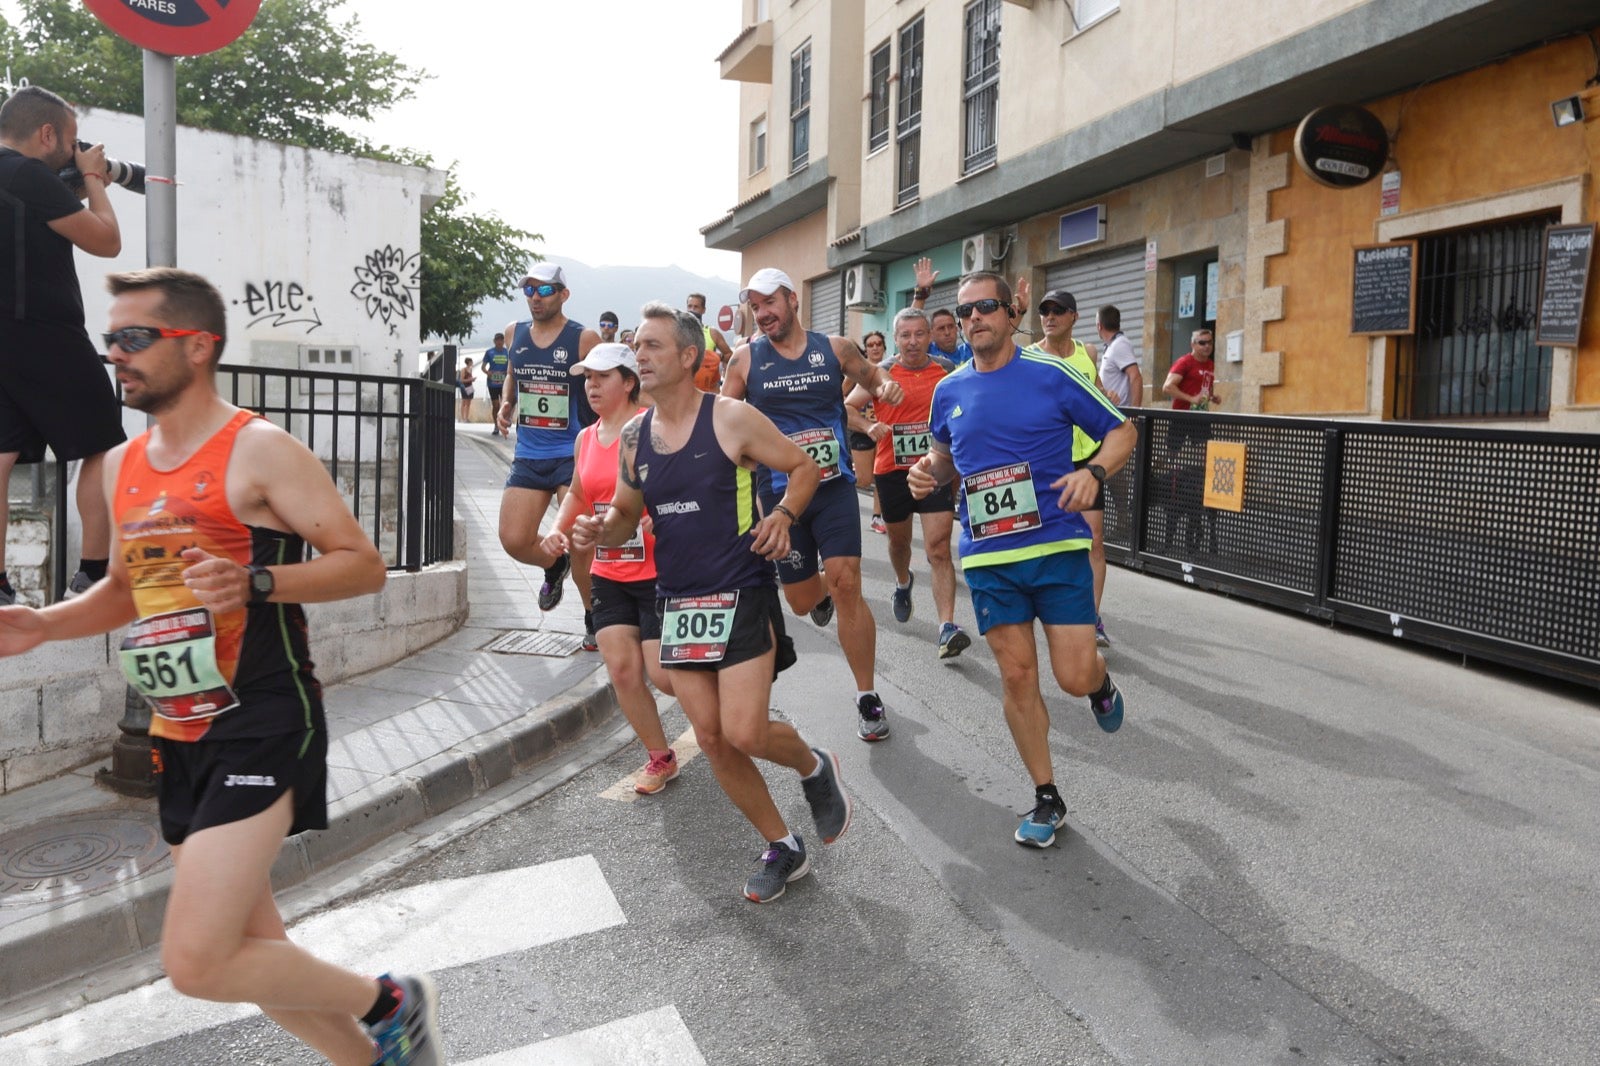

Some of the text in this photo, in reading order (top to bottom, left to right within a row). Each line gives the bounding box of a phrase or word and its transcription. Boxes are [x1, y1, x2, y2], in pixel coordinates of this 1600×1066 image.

[542, 369, 567, 377] PAZITO
[763, 379, 793, 389] PAZITO
[800, 374, 830, 384] PAZITO
[538, 397, 549, 413] 6
[897, 435, 931, 452] 114
[976, 475, 987, 484] GRAN
[987, 471, 1003, 481] PREMIO
[1010, 466, 1026, 476] FONDO
[984, 487, 1017, 515] 84
[676, 613, 725, 639] 805
[135, 646, 200, 690] 561
